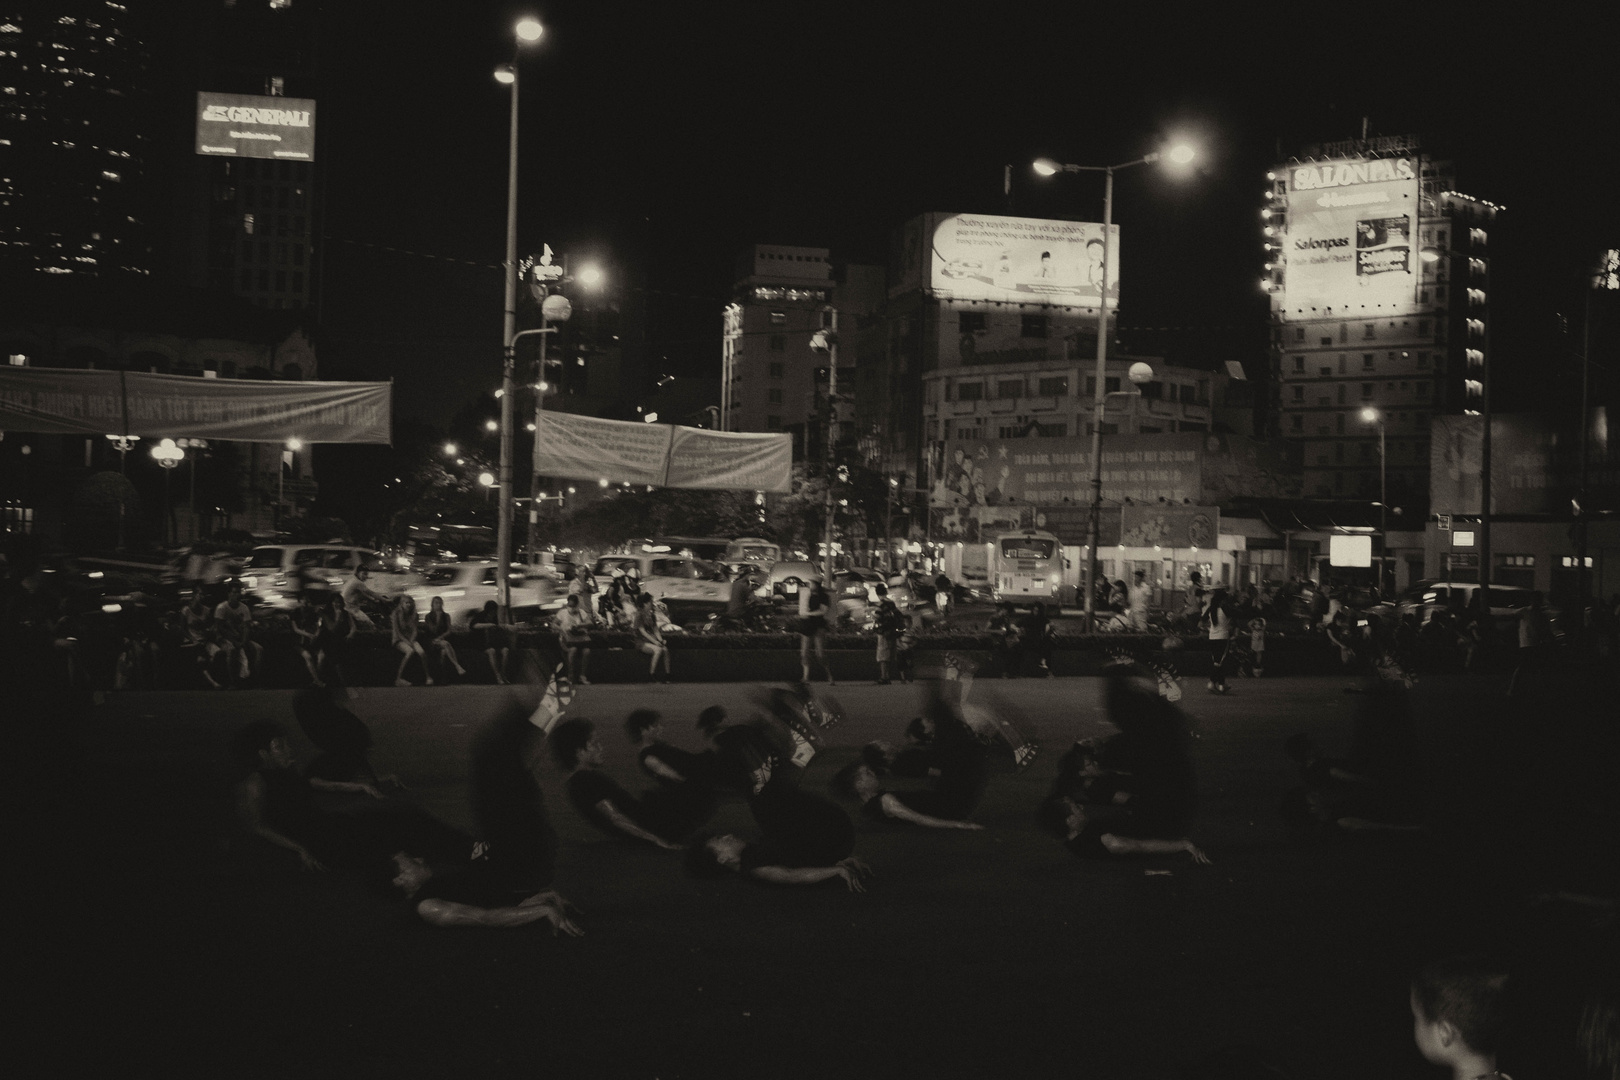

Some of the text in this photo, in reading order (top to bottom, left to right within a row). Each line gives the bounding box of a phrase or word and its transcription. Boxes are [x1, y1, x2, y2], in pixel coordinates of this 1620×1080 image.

[228, 106, 311, 127] GENERALI
[1294, 158, 1415, 190] SALONPAS
[1294, 237, 1350, 251] Salonpas
